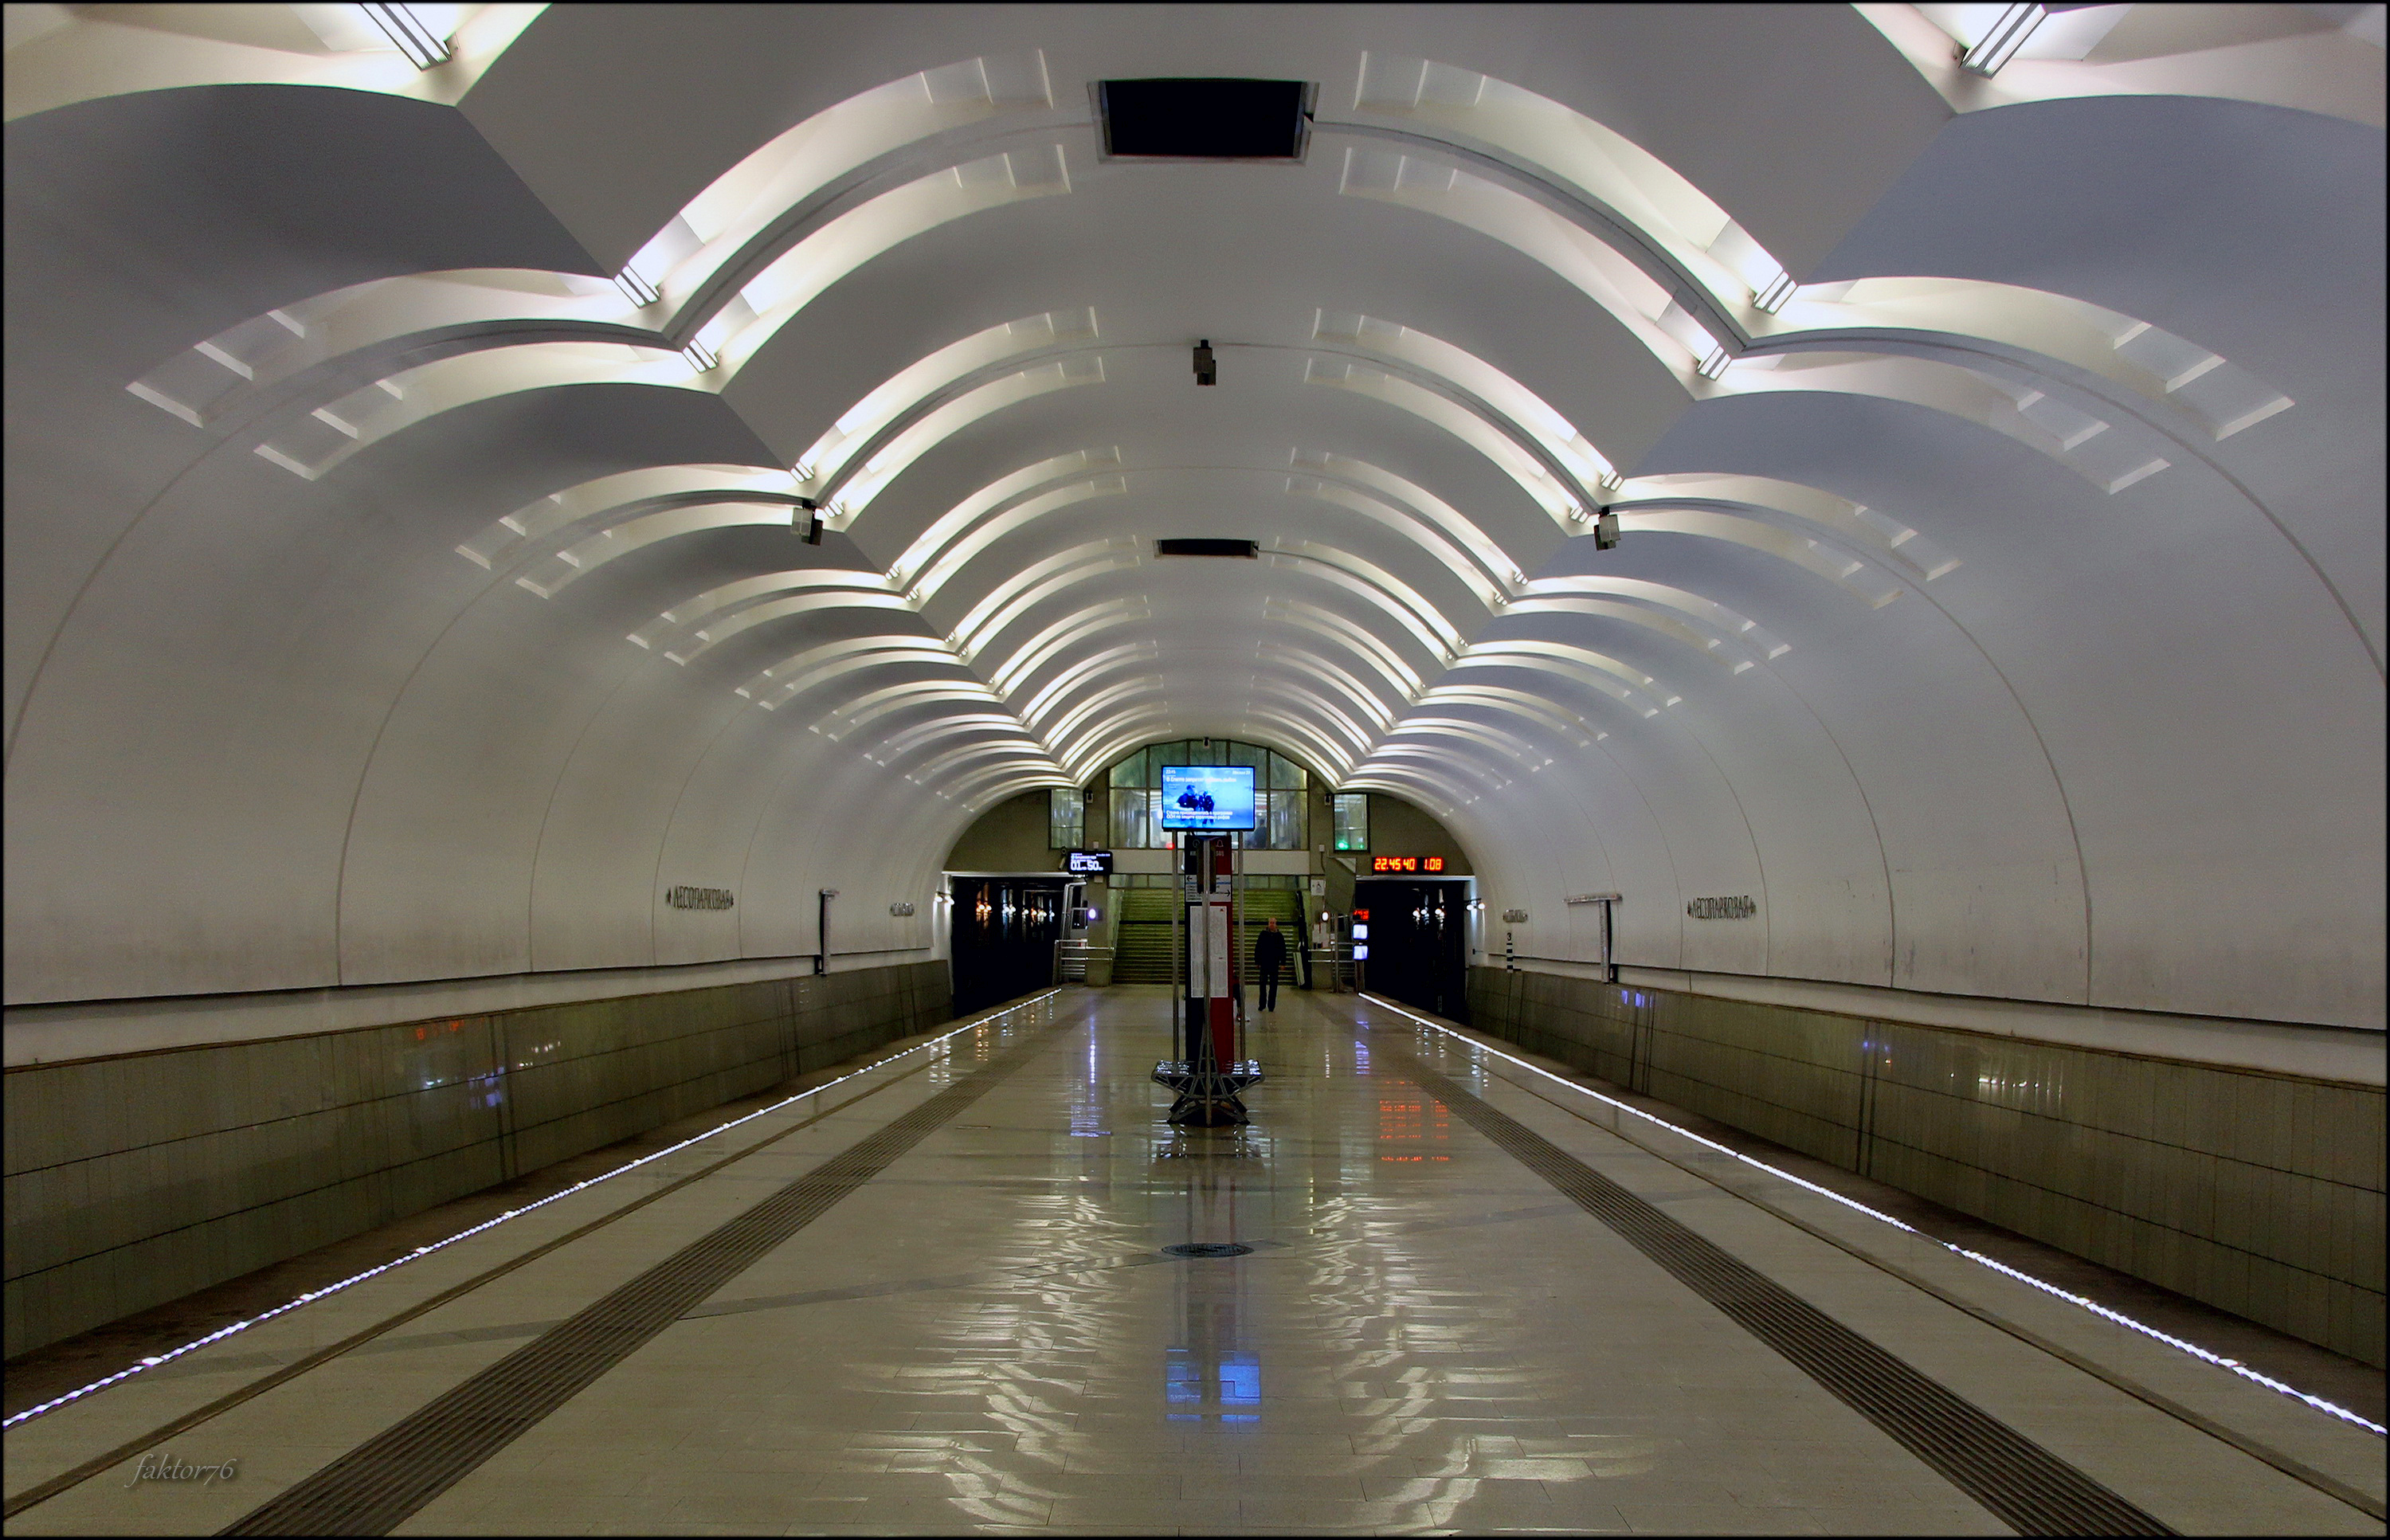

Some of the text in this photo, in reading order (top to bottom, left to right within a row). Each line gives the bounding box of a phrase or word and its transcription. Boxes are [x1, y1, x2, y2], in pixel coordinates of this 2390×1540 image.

[1087, 860, 1099, 871] 50
[1403, 858, 1416, 870] 40
[673, 885, 731, 910] ЛЕСОПАРКОВАЯ
[1691, 895, 1749, 919] ЛЕСОПАРКОВАЯ
[1506, 932, 1512, 941] 3
